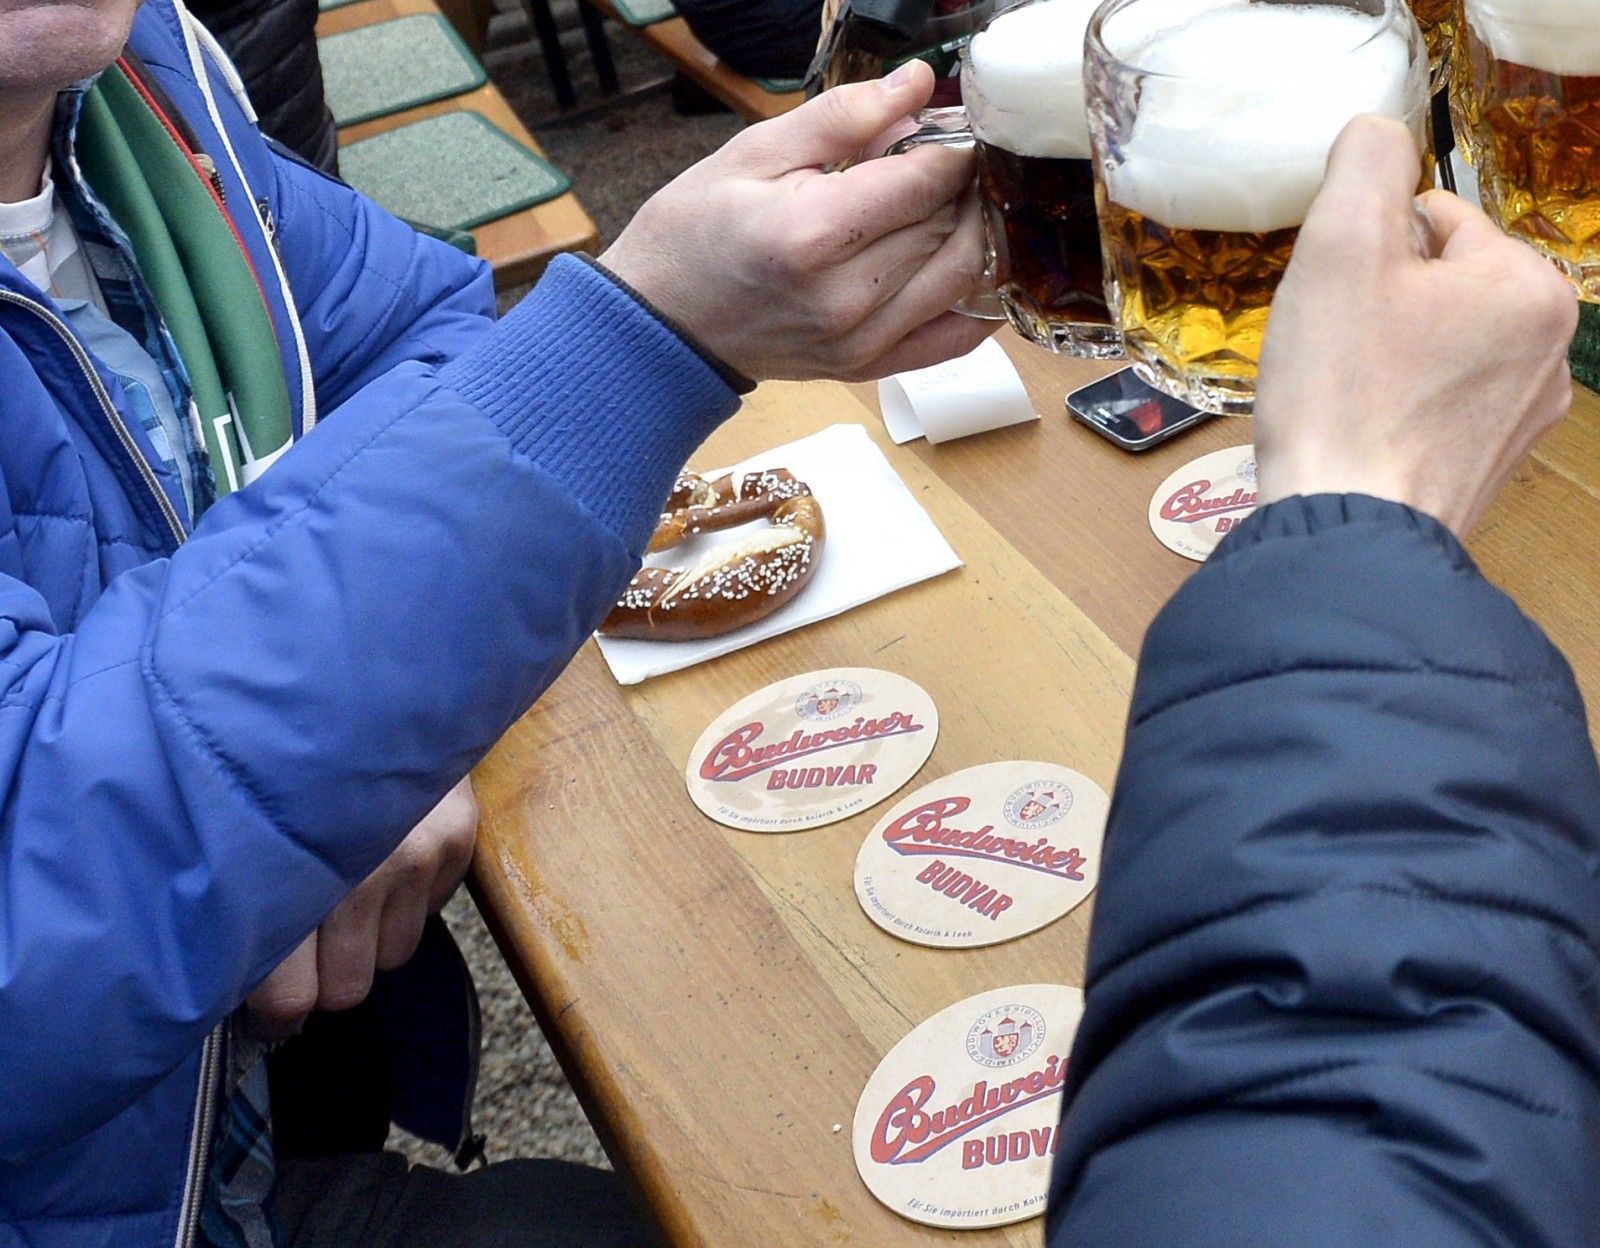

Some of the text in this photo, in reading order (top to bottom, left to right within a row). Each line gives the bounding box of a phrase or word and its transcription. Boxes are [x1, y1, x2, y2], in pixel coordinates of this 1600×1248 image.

[700, 711, 924, 781] Budweiser
[767, 764, 877, 790] BUDVAR
[882, 796, 1085, 881] Budweiser
[916, 860, 1013, 921] BUDVAR
[908, 1198, 922, 1209] Für
[924, 1203, 938, 1214] Sie
[940, 1208, 988, 1218] importiert
